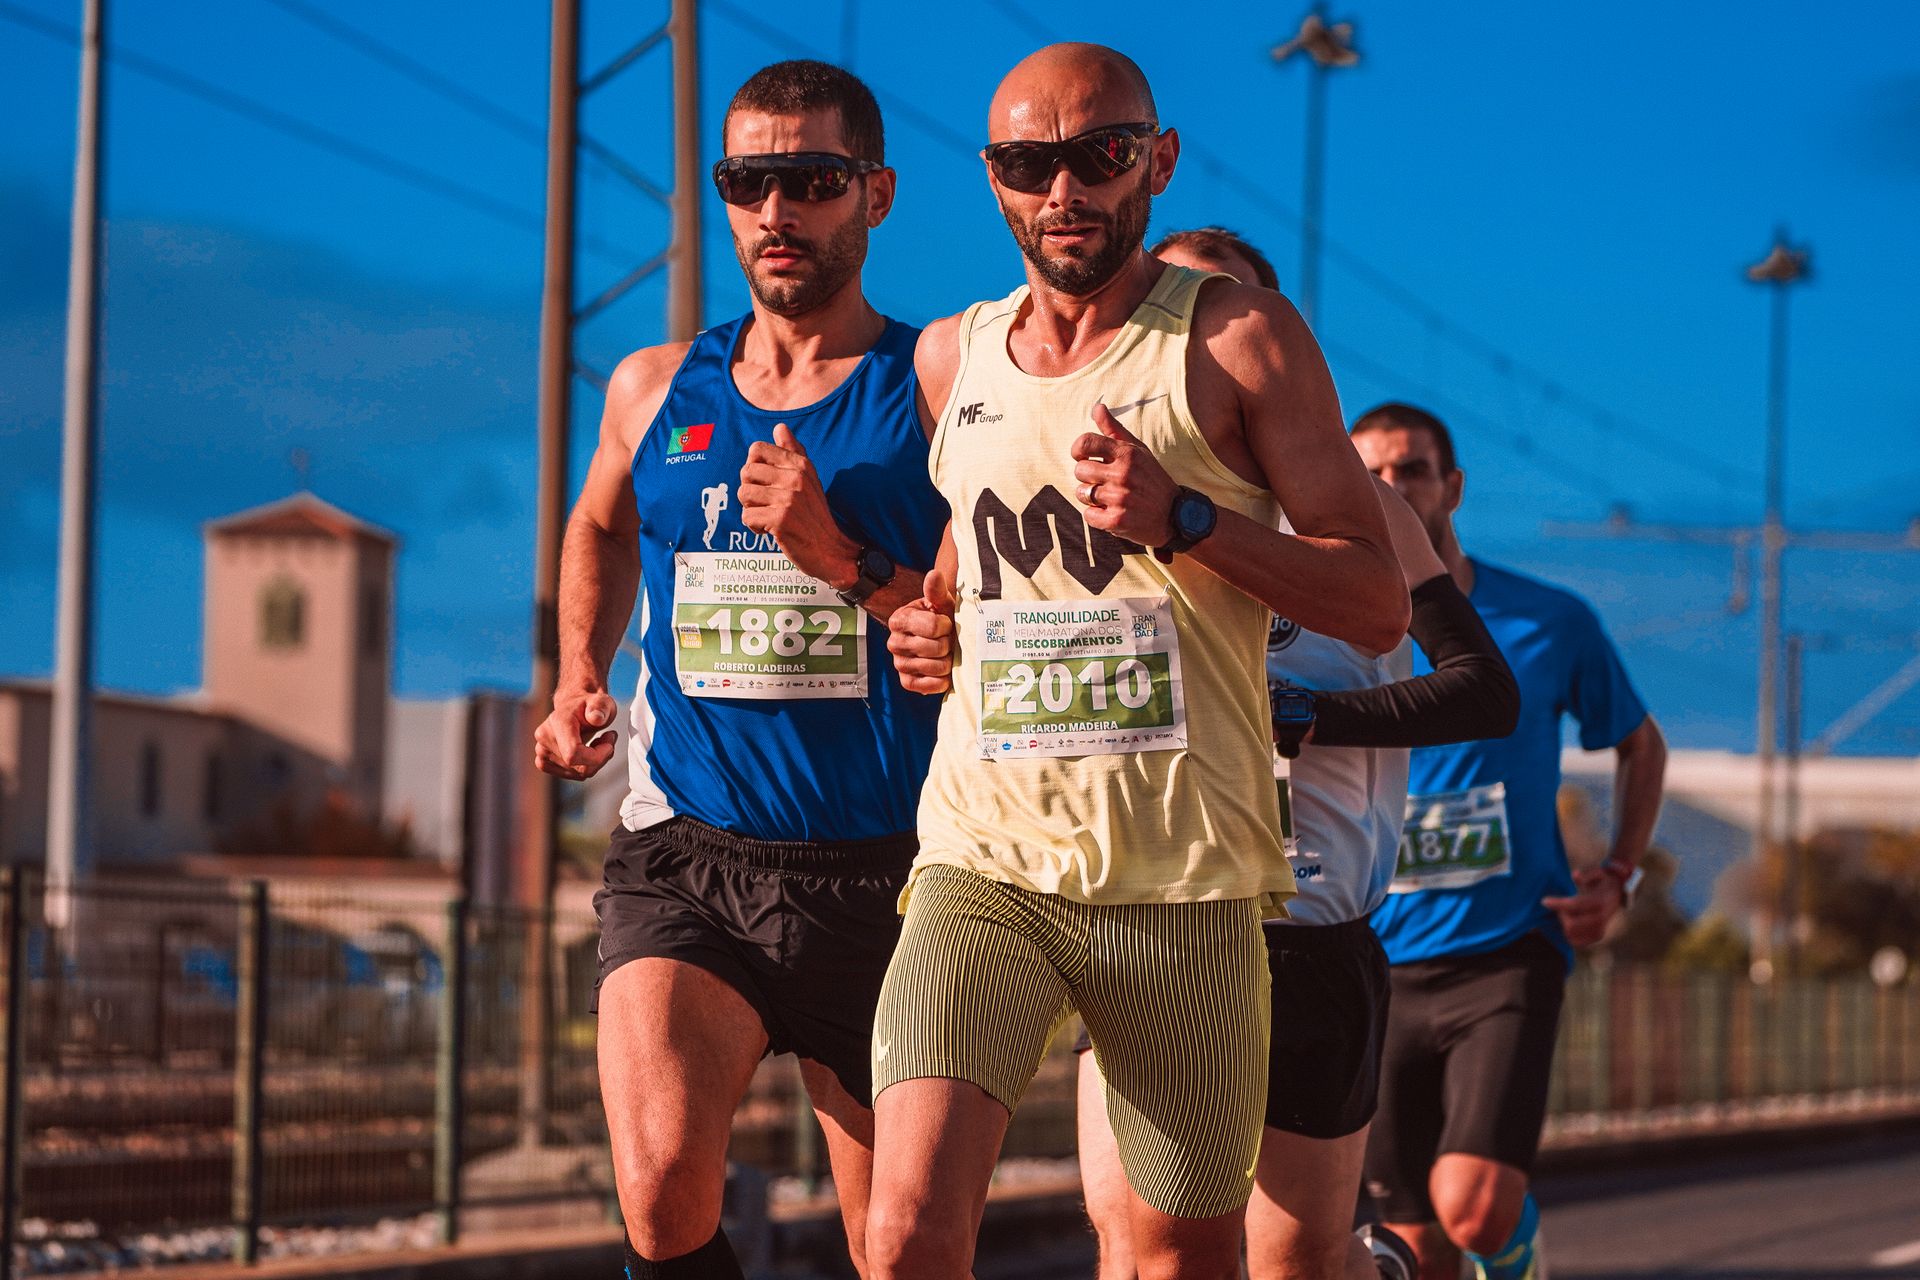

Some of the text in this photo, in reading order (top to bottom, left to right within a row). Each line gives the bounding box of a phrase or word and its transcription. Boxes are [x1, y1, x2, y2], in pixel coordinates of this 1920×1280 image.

[957, 402, 1003, 427] MF Grupo
[665, 453, 706, 465] PORTUGAL
[729, 531, 781, 551] RUN
[715, 559, 800, 572] TRANQUILIDA
[685, 580, 704, 588] DADE
[714, 574, 818, 584] MEIA MARATONA DOS
[713, 585, 817, 595] DESCOBRIMENTOS
[1013, 609, 1120, 625] TRANQUILIDADE
[1131, 614, 1156, 623] TRAN
[986, 620, 1005, 628] TRAN
[706, 608, 843, 657] 1882
[1014, 625, 1122, 638] MEIA MARATONA DOS
[1135, 629, 1158, 638] DADE
[987, 635, 1006, 643] DADE
[1014, 636, 1123, 648] DESCOBRIMENTOS
[714, 662, 806, 673] ROBERTO LADEIRAS
[1006, 659, 1152, 714] 2010
[1021, 720, 1118, 734] RICARDO MADEIRA
[1401, 823, 1489, 864] 1877
